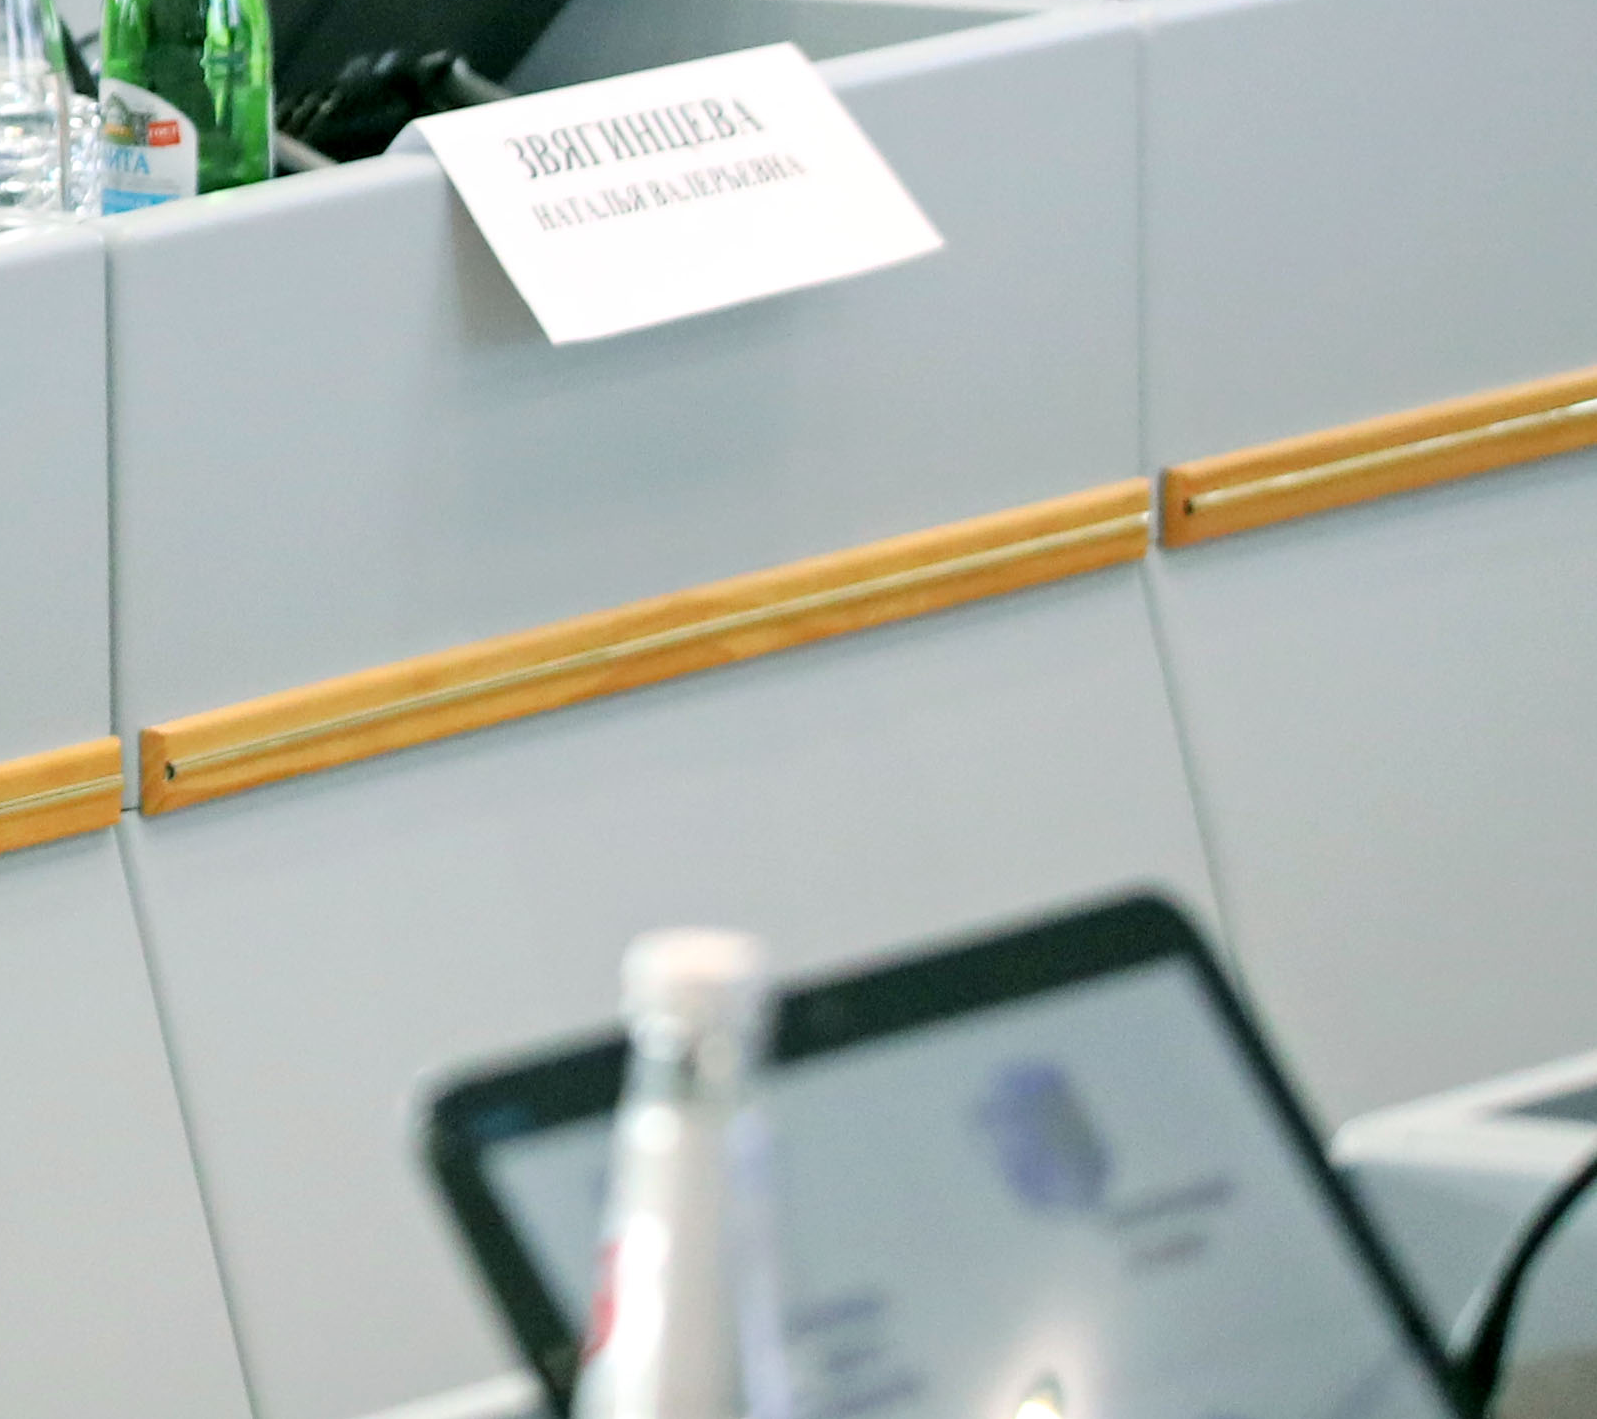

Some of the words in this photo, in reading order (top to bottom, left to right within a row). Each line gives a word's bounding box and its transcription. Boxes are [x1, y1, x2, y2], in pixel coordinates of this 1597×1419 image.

[504, 96, 767, 180] ЗВЯГИНЦЕВА
[531, 183, 649, 233] НАТАЛЬЯ
[646, 153, 808, 208] ВАЛЕРЬЕВНА
